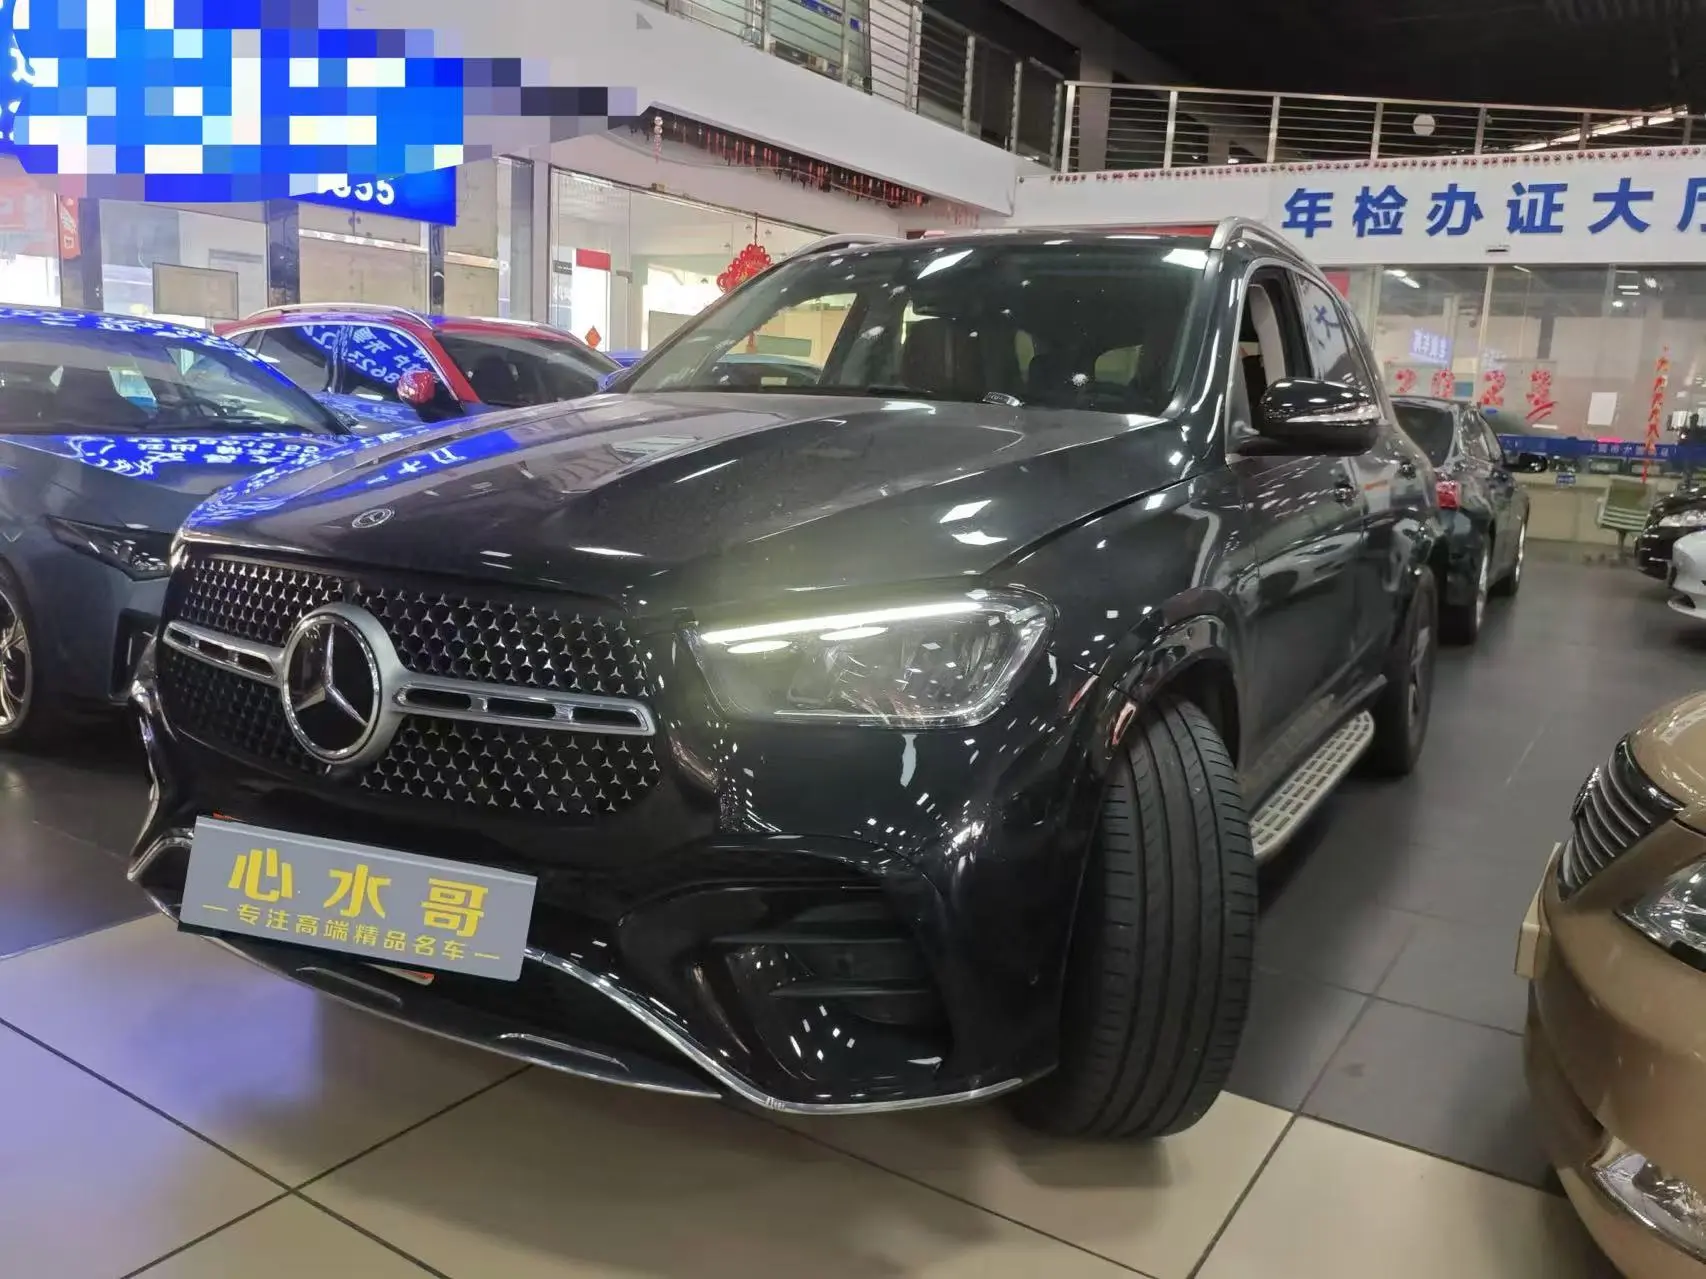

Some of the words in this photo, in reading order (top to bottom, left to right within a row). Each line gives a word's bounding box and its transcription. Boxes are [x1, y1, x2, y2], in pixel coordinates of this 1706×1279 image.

[227, 847, 489, 938] 心水哥
[236, 903, 466, 961] 专注高端精品名车
